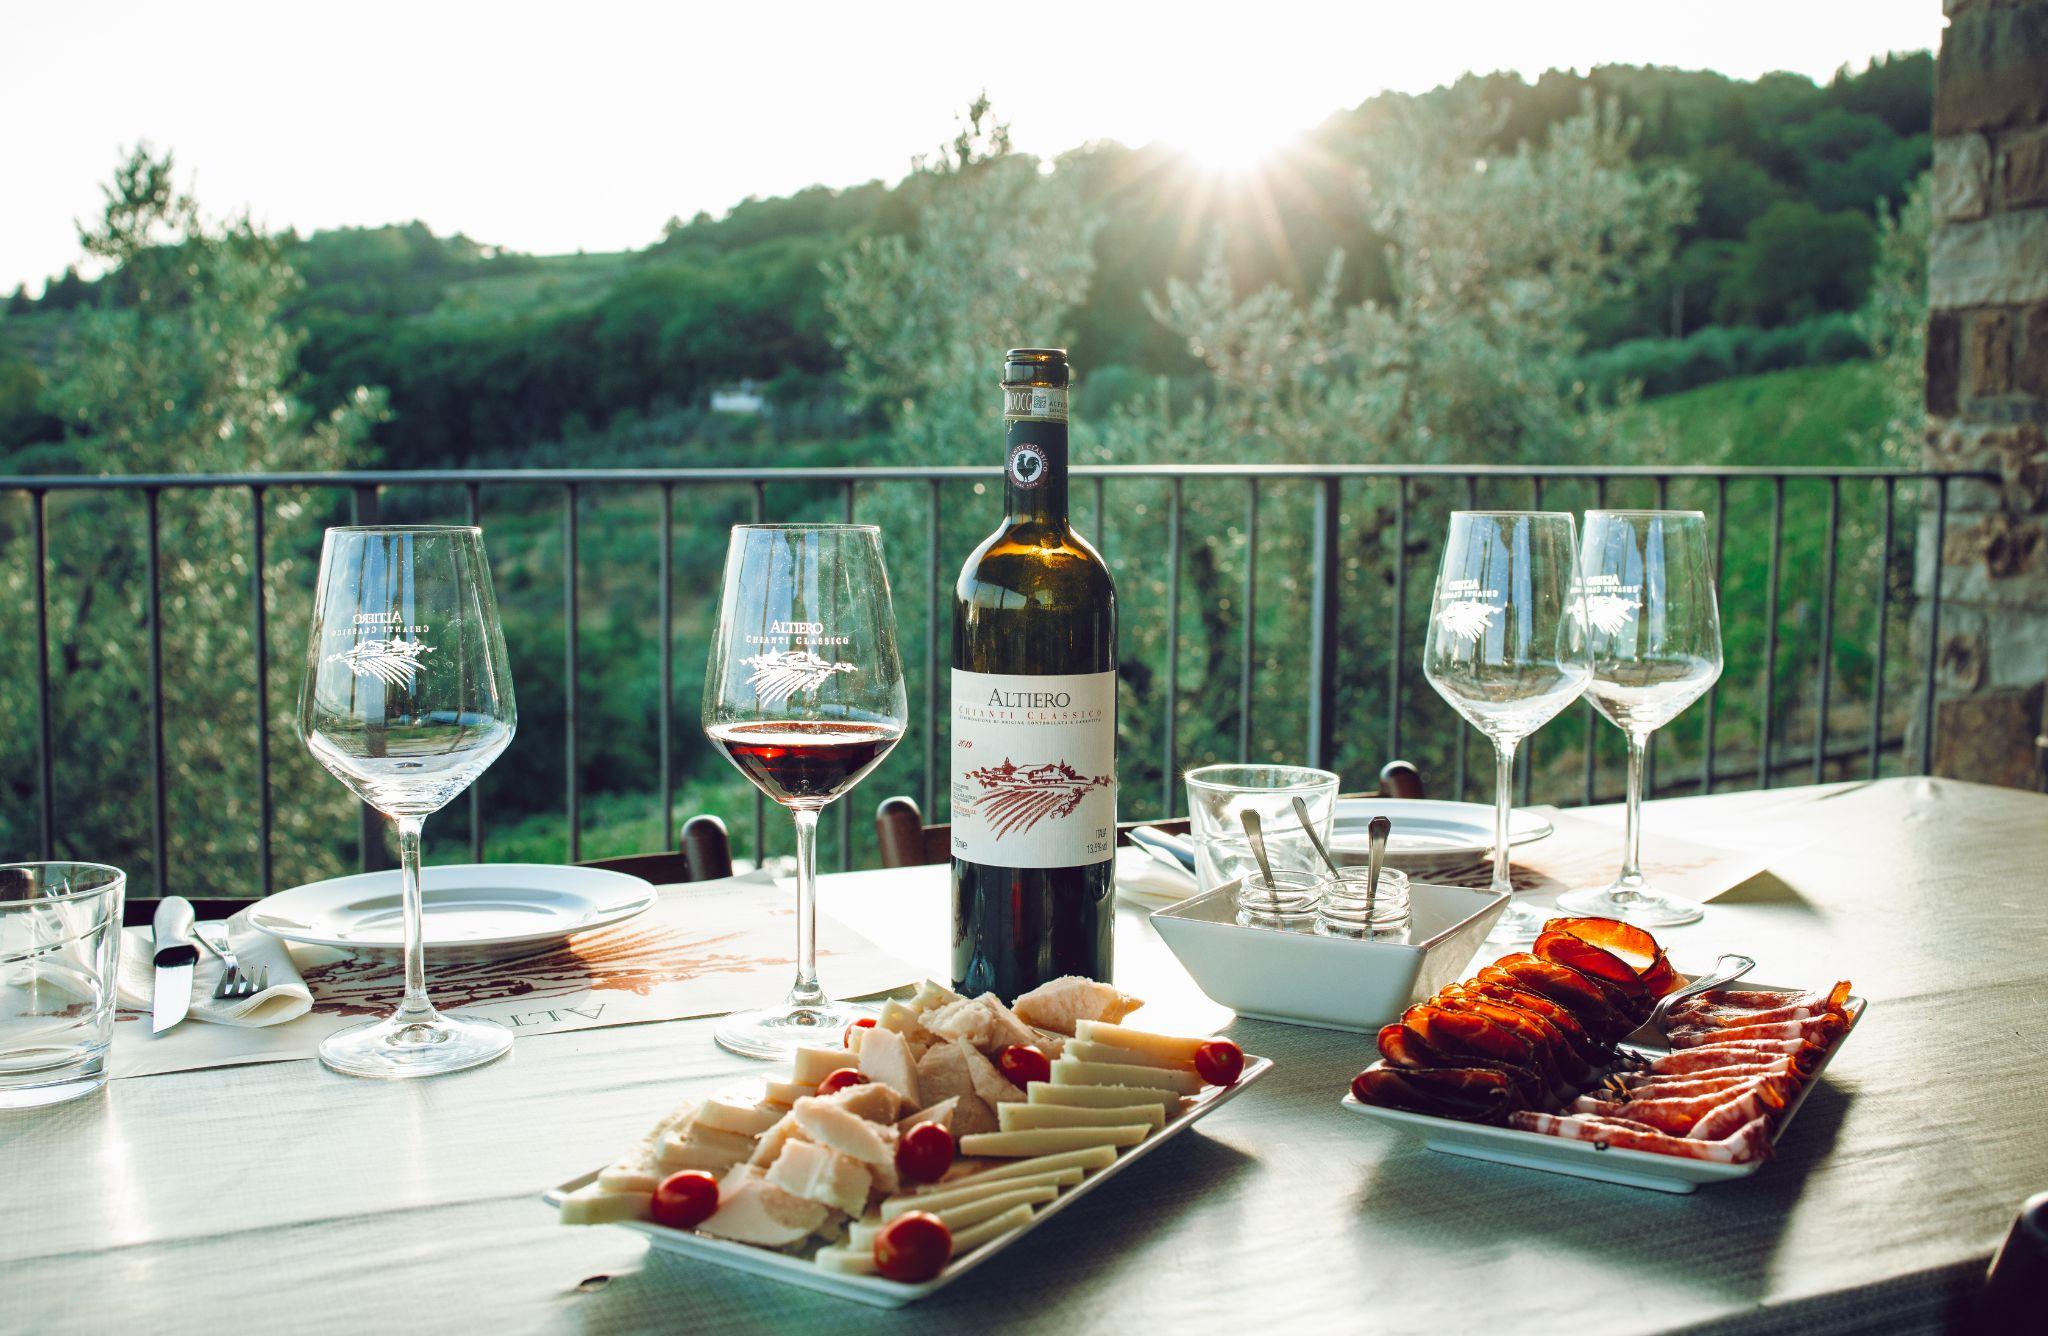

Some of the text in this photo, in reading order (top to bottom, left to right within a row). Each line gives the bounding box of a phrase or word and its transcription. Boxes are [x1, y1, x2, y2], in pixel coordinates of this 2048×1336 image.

[1026, 444, 1048, 472] CLASSICO
[769, 619, 824, 635] ALTIERO
[745, 635, 849, 645] CHIANTI CLASSICO
[988, 688, 1071, 708] ALTIERO
[958, 704, 1014, 720] CHIANTI
[1027, 709, 1102, 720] CLASSICO
